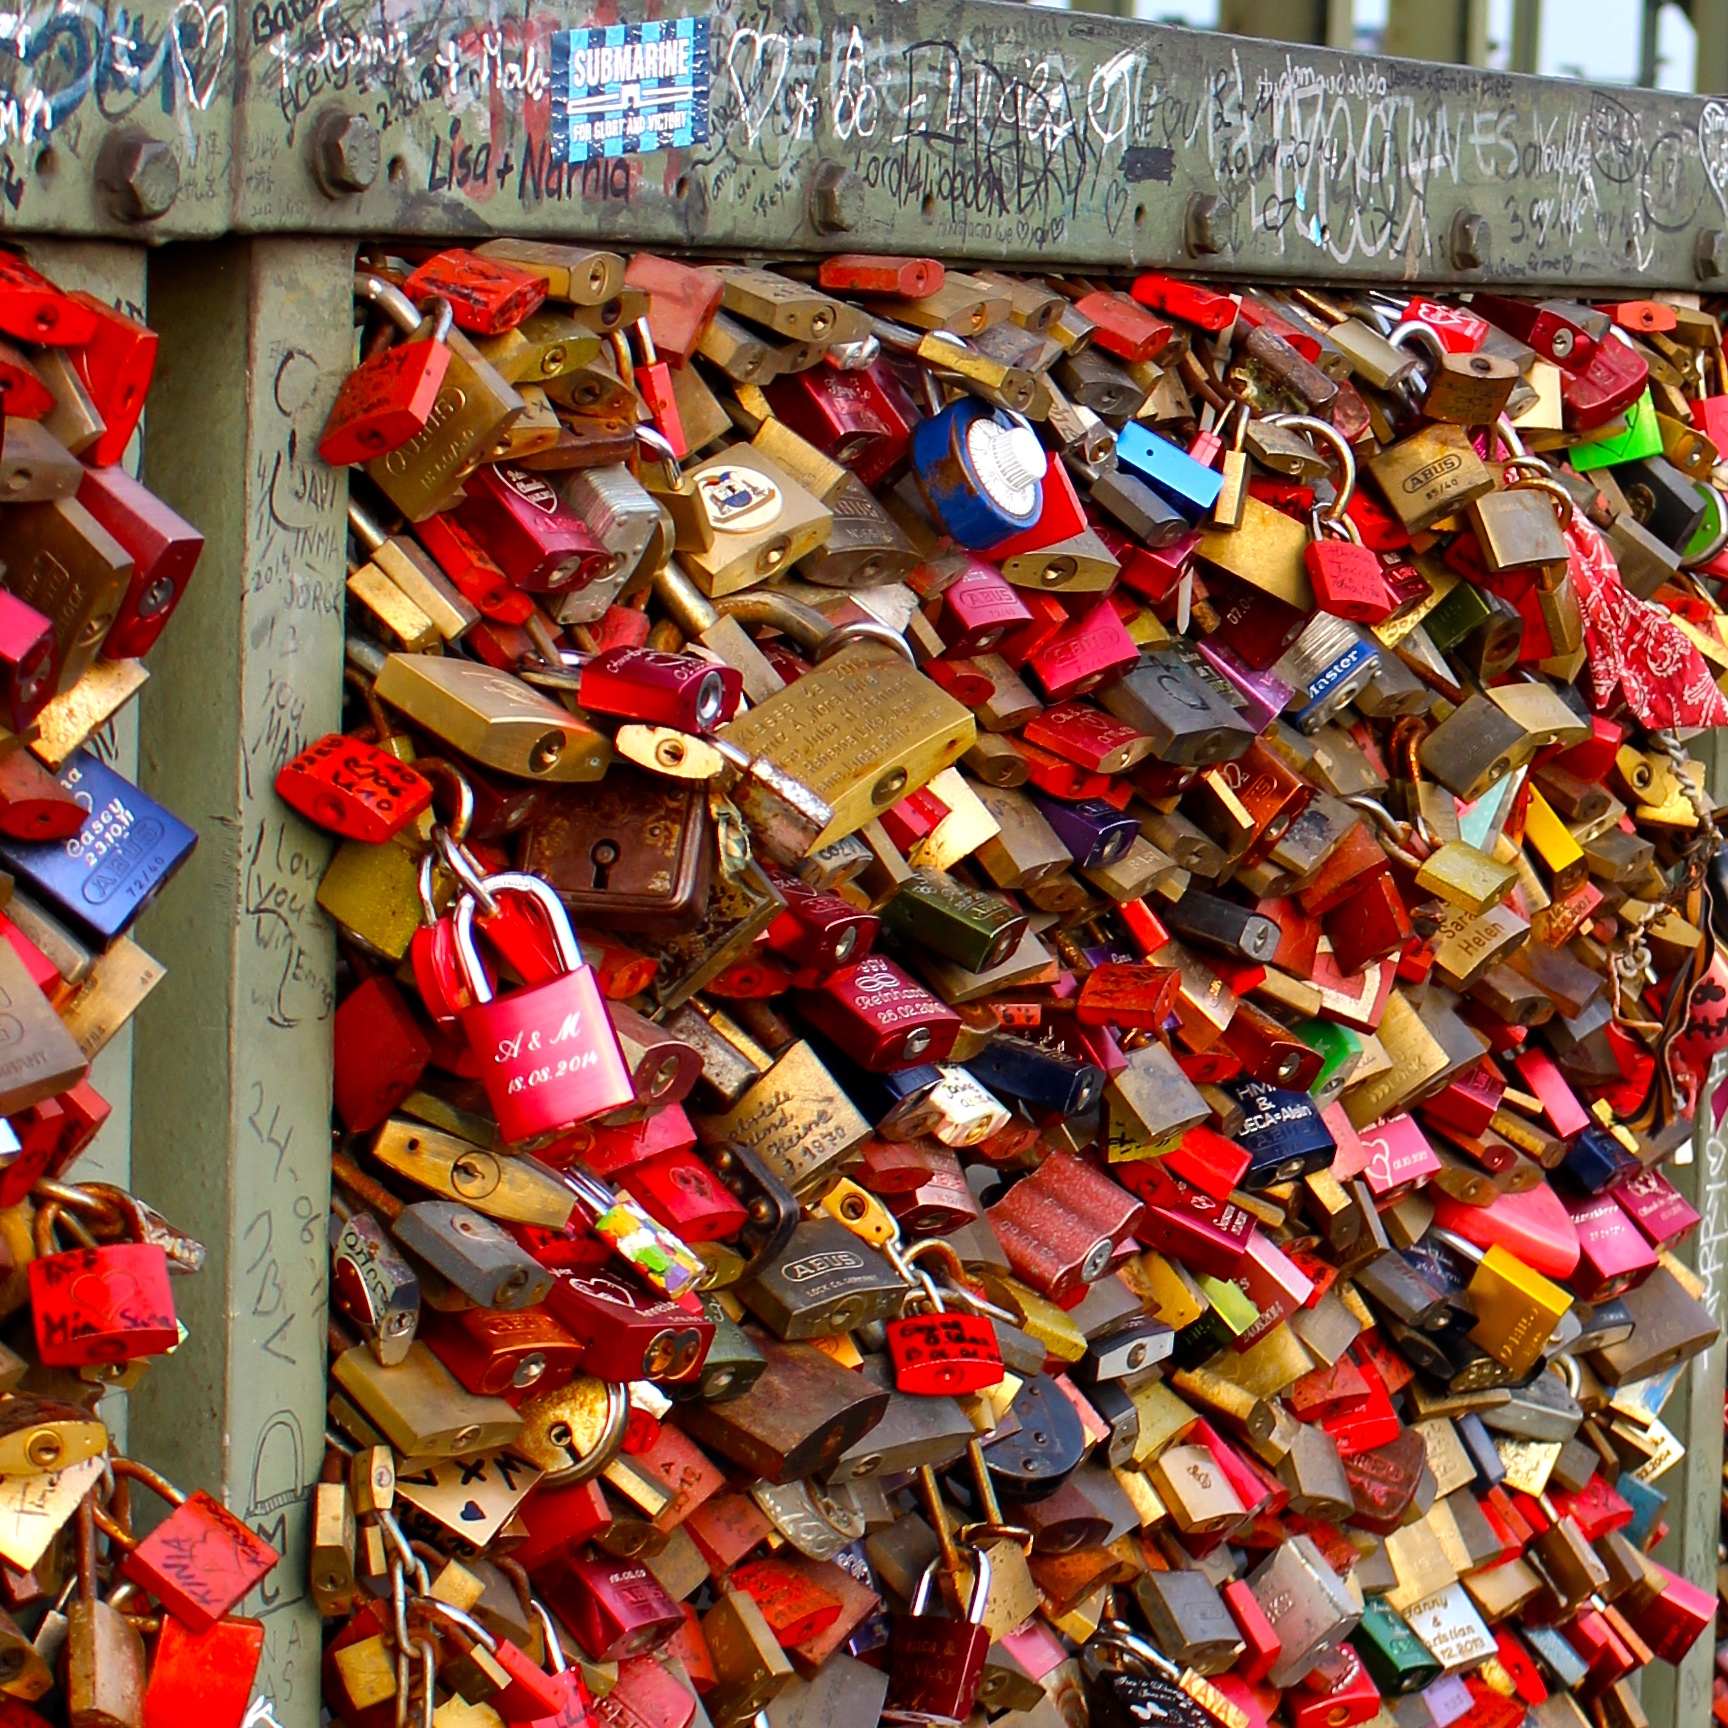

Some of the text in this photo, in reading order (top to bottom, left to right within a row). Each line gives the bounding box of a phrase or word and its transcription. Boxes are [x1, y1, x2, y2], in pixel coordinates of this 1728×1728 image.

[573, 38, 691, 88] SUBMARINE
[573, 110, 687, 143] FOR GLORY AND VICTORY
[428, 118, 491, 193] Lisa
[1409, 456, 1456, 490] ABUS
[968, 589, 1015, 606] ABUS
[66, 796, 126, 859] Casey
[93, 822, 160, 897] ABUS
[1440, 909, 1480, 939] Sara
[1457, 920, 1506, 957] Helen
[494, 1011, 581, 1064] A & M
[1256, 1097, 1276, 1112] &
[794, 1253, 857, 1279] ABUS
